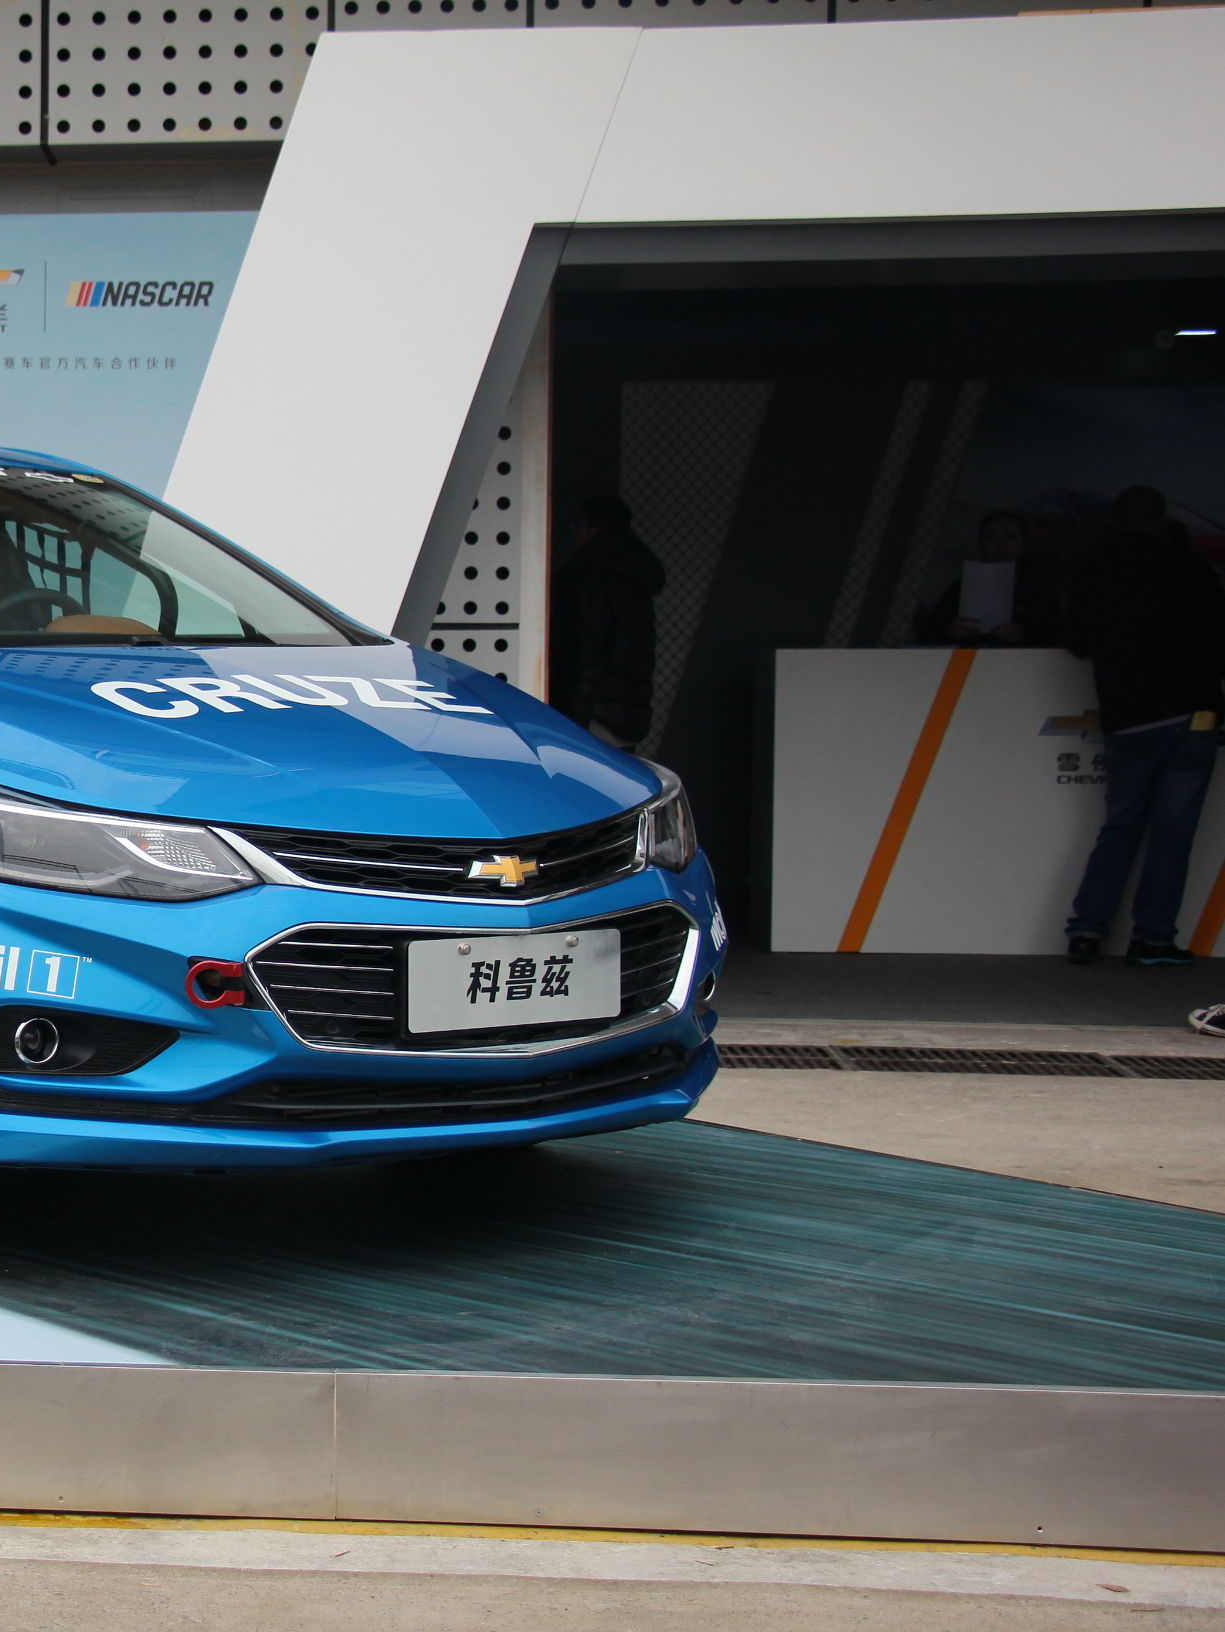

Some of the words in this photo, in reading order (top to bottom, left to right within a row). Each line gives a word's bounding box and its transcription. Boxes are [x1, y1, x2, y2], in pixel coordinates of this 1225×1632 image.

[101, 281, 215, 307] NASCAR
[90, 674, 494, 718] CRUZE
[466, 955, 574, 1004] 科鲁兹
